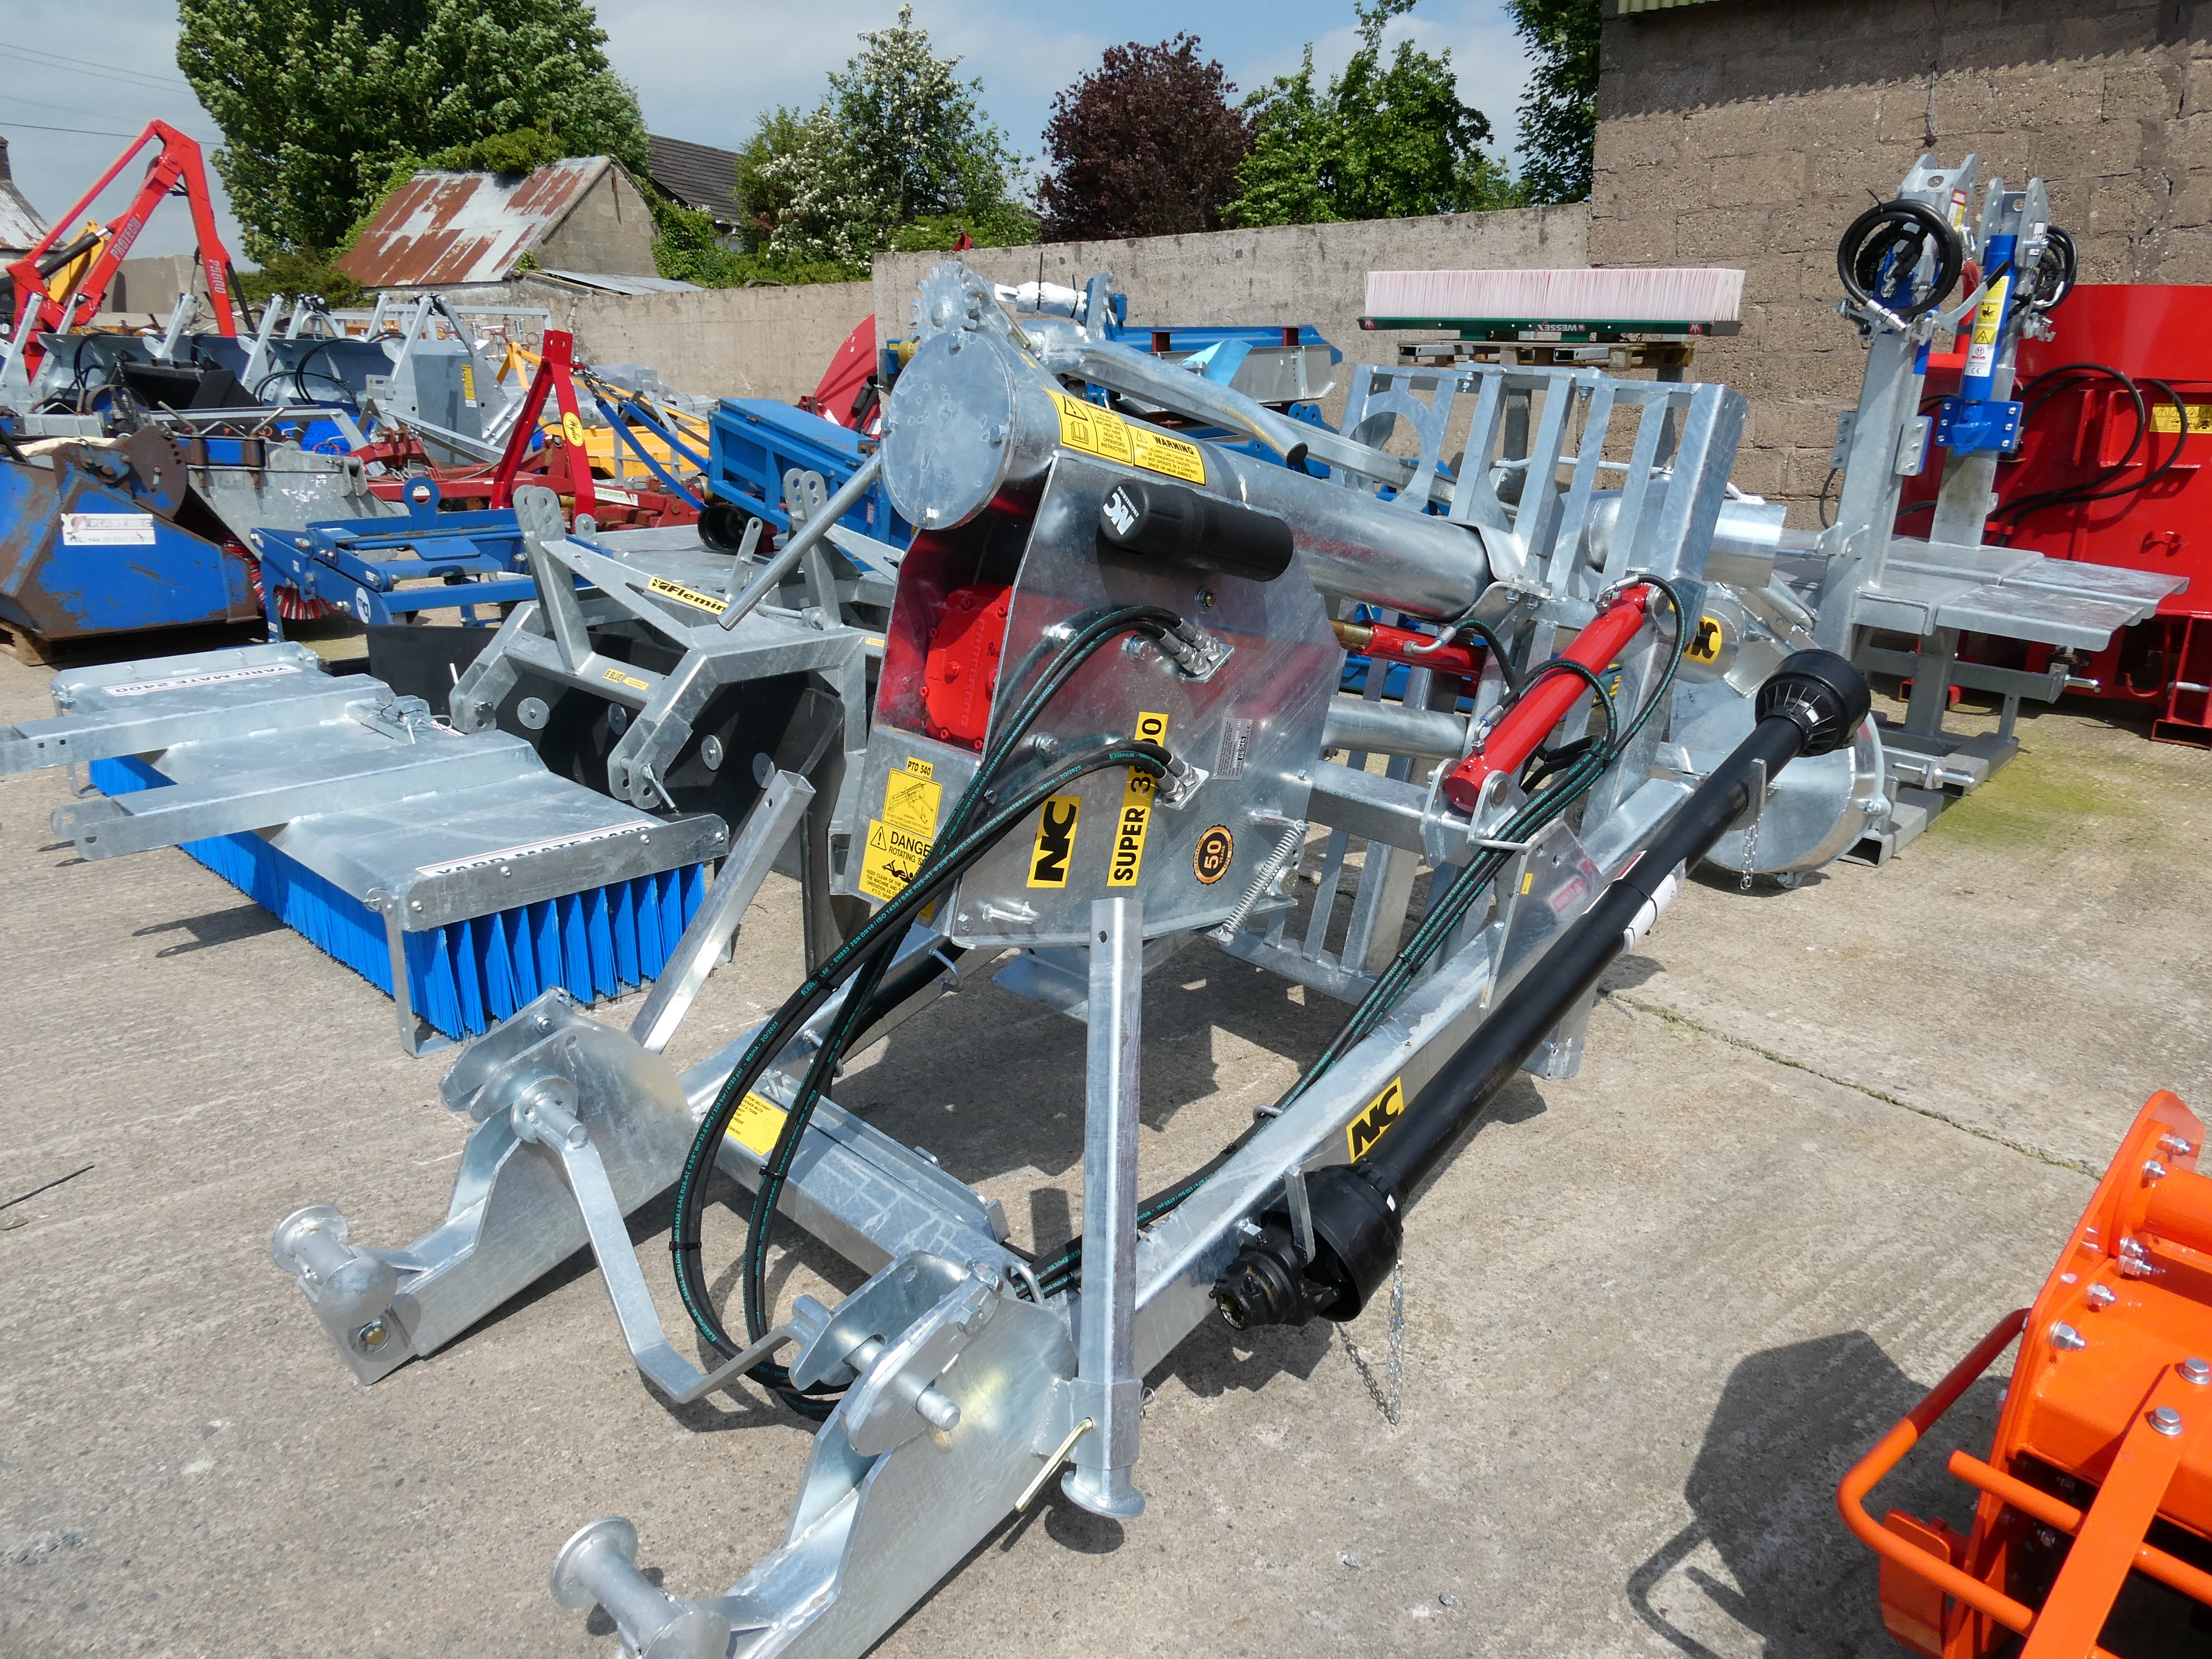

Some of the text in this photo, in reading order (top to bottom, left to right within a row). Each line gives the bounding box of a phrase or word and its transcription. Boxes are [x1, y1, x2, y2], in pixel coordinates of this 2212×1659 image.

[110, 216, 142, 262] PROTECH
[568, 418, 581, 441] Wylie
[1152, 435, 1195, 455] WARNING
[1154, 454, 1175, 463] DANGEROUS
[1156, 459, 1172, 468] OPERATE
[1181, 466, 1198, 475] CONFINED
[1185, 458, 1200, 466] RELEASE
[1103, 492, 1135, 535] NC
[1117, 486, 1139, 518] ENGINEERING
[116, 667, 288, 693] YARD-MATE 2400
[907, 761, 931, 775] PTO 540
[891, 831, 932, 857] DANGE
[1033, 801, 1077, 882] NC
[1114, 808, 1146, 881] SUPER
[889, 846, 925, 865] ROTATING S
[1195, 838, 1205, 873] CELEBRATING
[1204, 840, 1222, 869] 50
[867, 881, 885, 892] OPERATION
[873, 877, 889, 888] MACHINE
[876, 873, 888, 881] CLEAR
[755, 1100, 771, 1112] DELIVERY
[1352, 1084, 1400, 1158] NC
